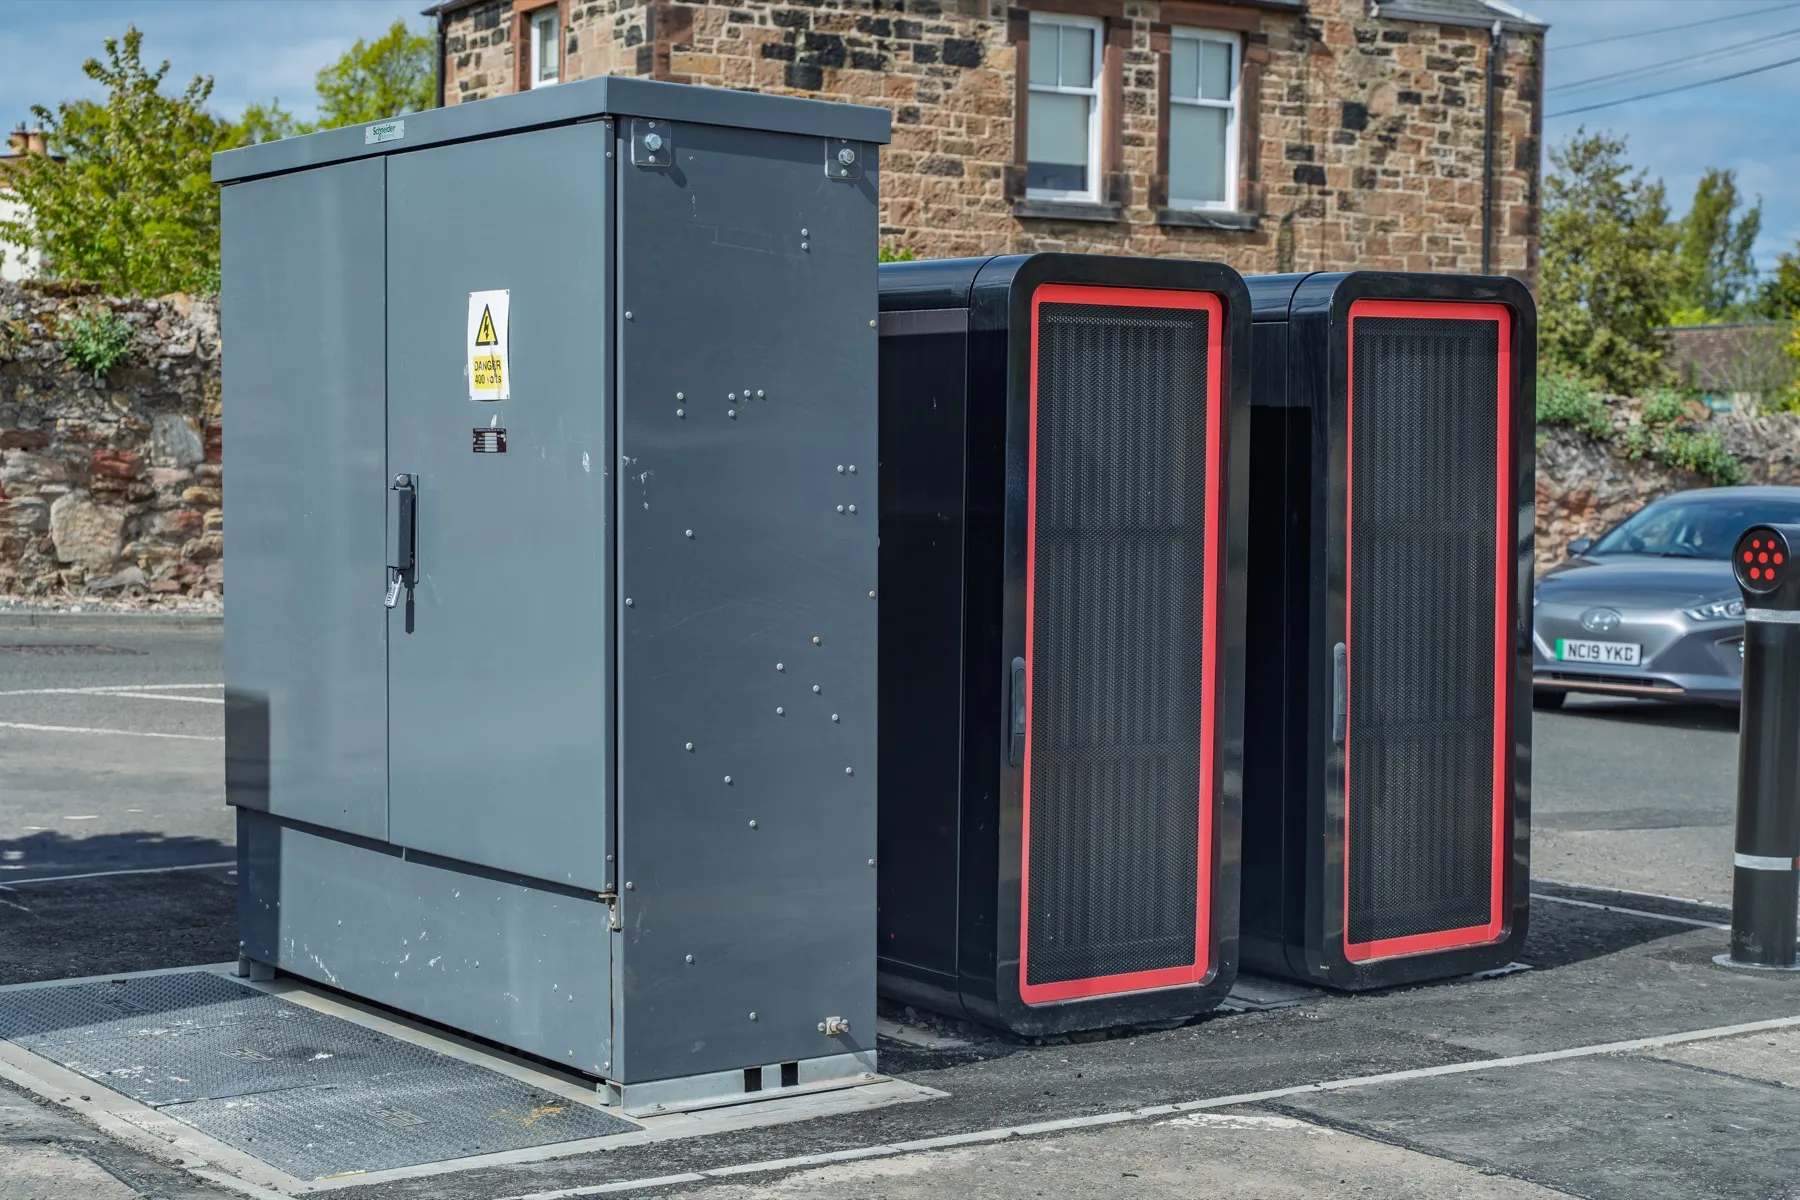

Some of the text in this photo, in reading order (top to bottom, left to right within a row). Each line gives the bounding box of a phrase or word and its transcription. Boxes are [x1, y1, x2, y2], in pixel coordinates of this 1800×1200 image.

[372, 124, 396, 136] Schneider
[474, 374, 486, 384] 400
[1568, 643, 1600, 659] NC19
